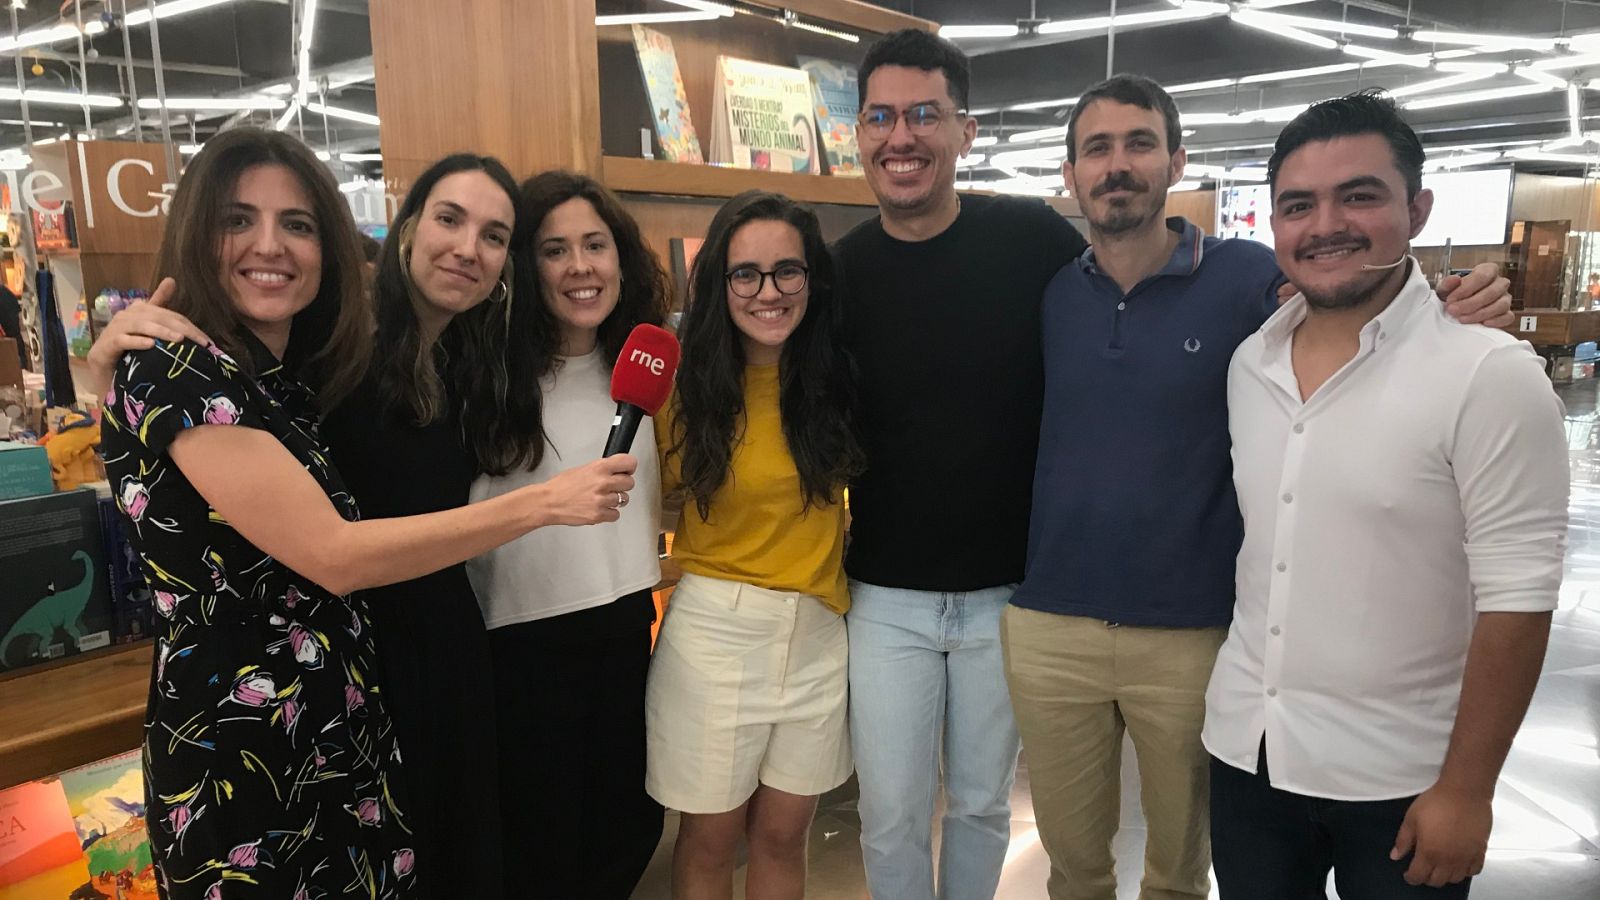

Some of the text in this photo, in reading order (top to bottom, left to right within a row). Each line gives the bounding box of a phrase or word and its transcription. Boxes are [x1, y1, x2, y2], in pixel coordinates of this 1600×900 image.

[731, 109, 780, 132] MISTERIOS
[739, 128, 806, 152] MUNDO ANIMAL
[629, 348, 665, 376] rne
